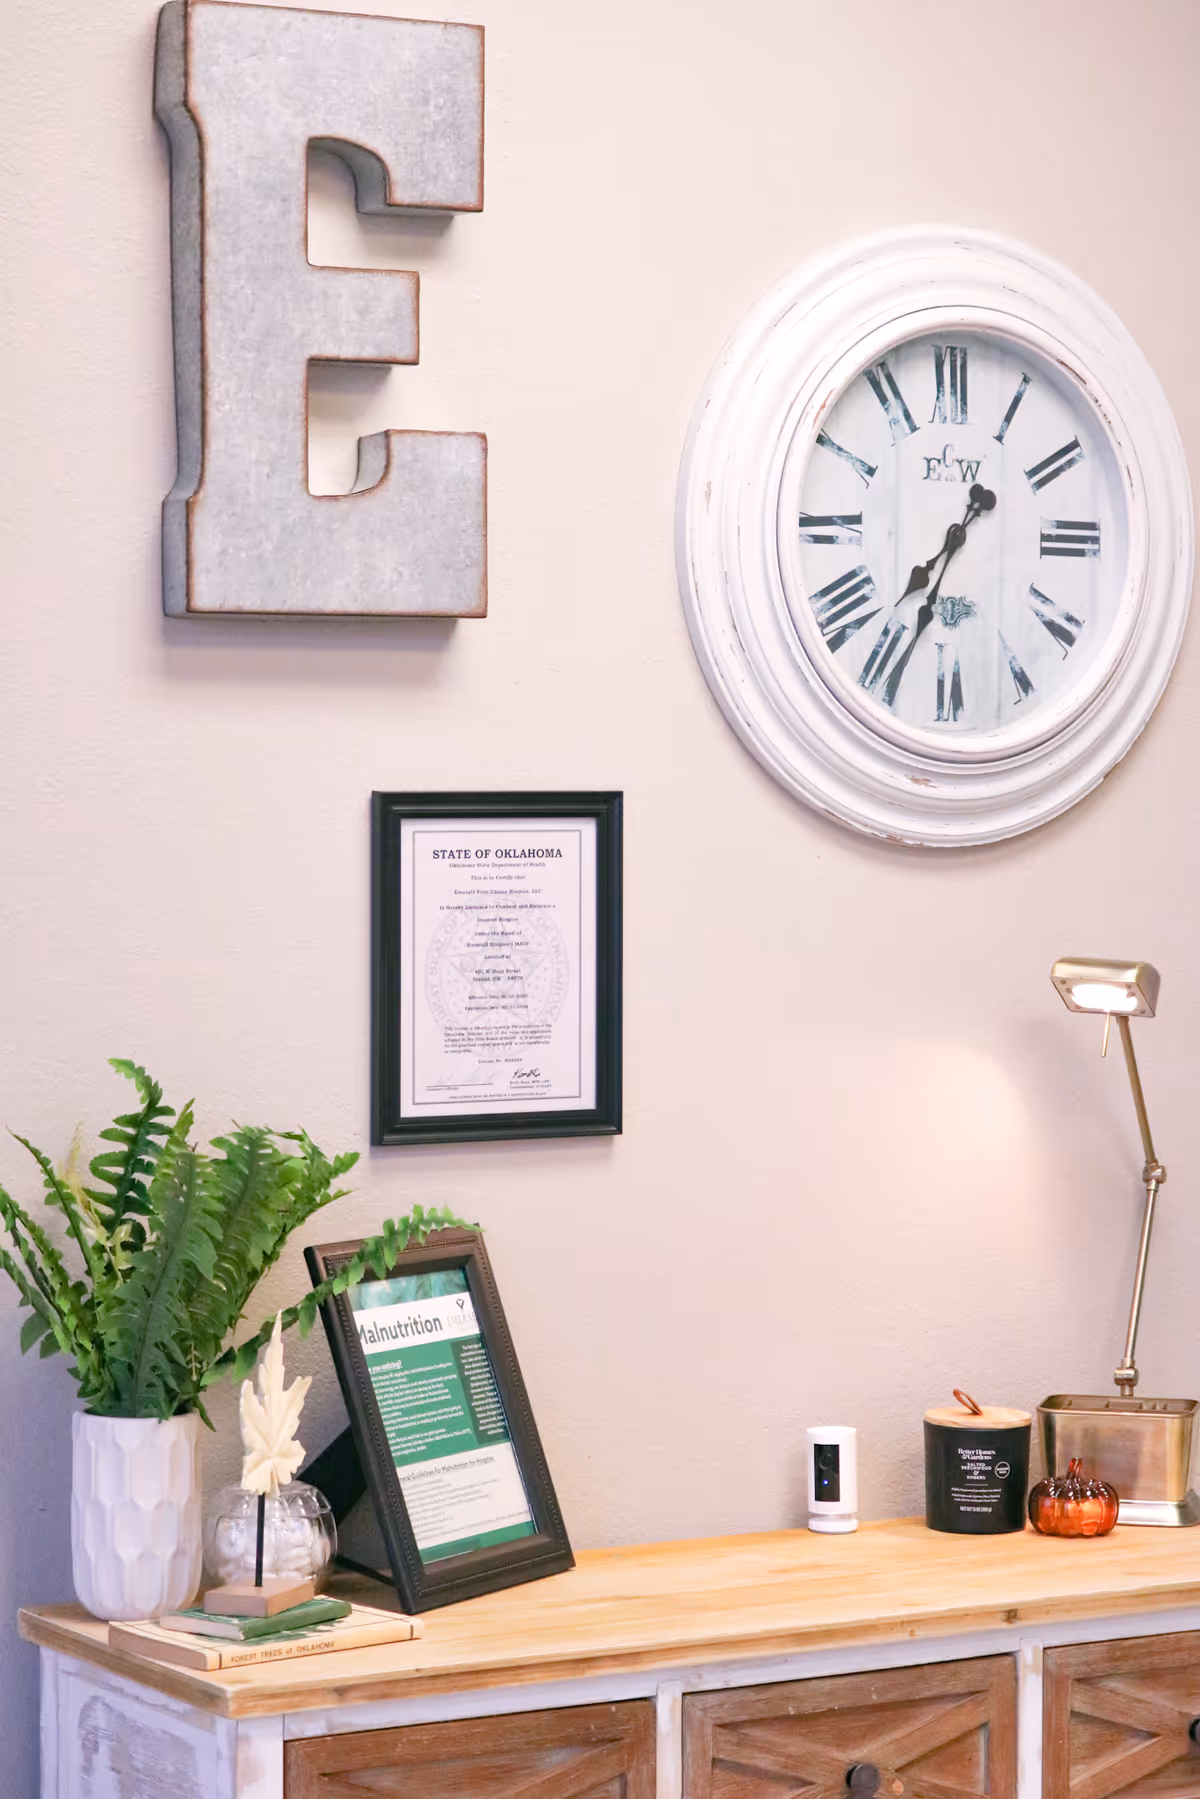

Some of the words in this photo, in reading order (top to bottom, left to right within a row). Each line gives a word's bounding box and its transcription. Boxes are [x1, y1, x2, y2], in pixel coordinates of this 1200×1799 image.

[154, 0, 488, 620] E
[433, 849, 472, 860] STATE
[475, 849, 492, 859] OF
[495, 848, 563, 859] OKLAHOMA
[491, 861, 522, 869] Department
[358, 1314, 443, 1345] Malnutrition
[231, 1653, 257, 1663] FOREST
[261, 1648, 283, 1658] TREES
[296, 1641, 336, 1653] OKLAHOMA
